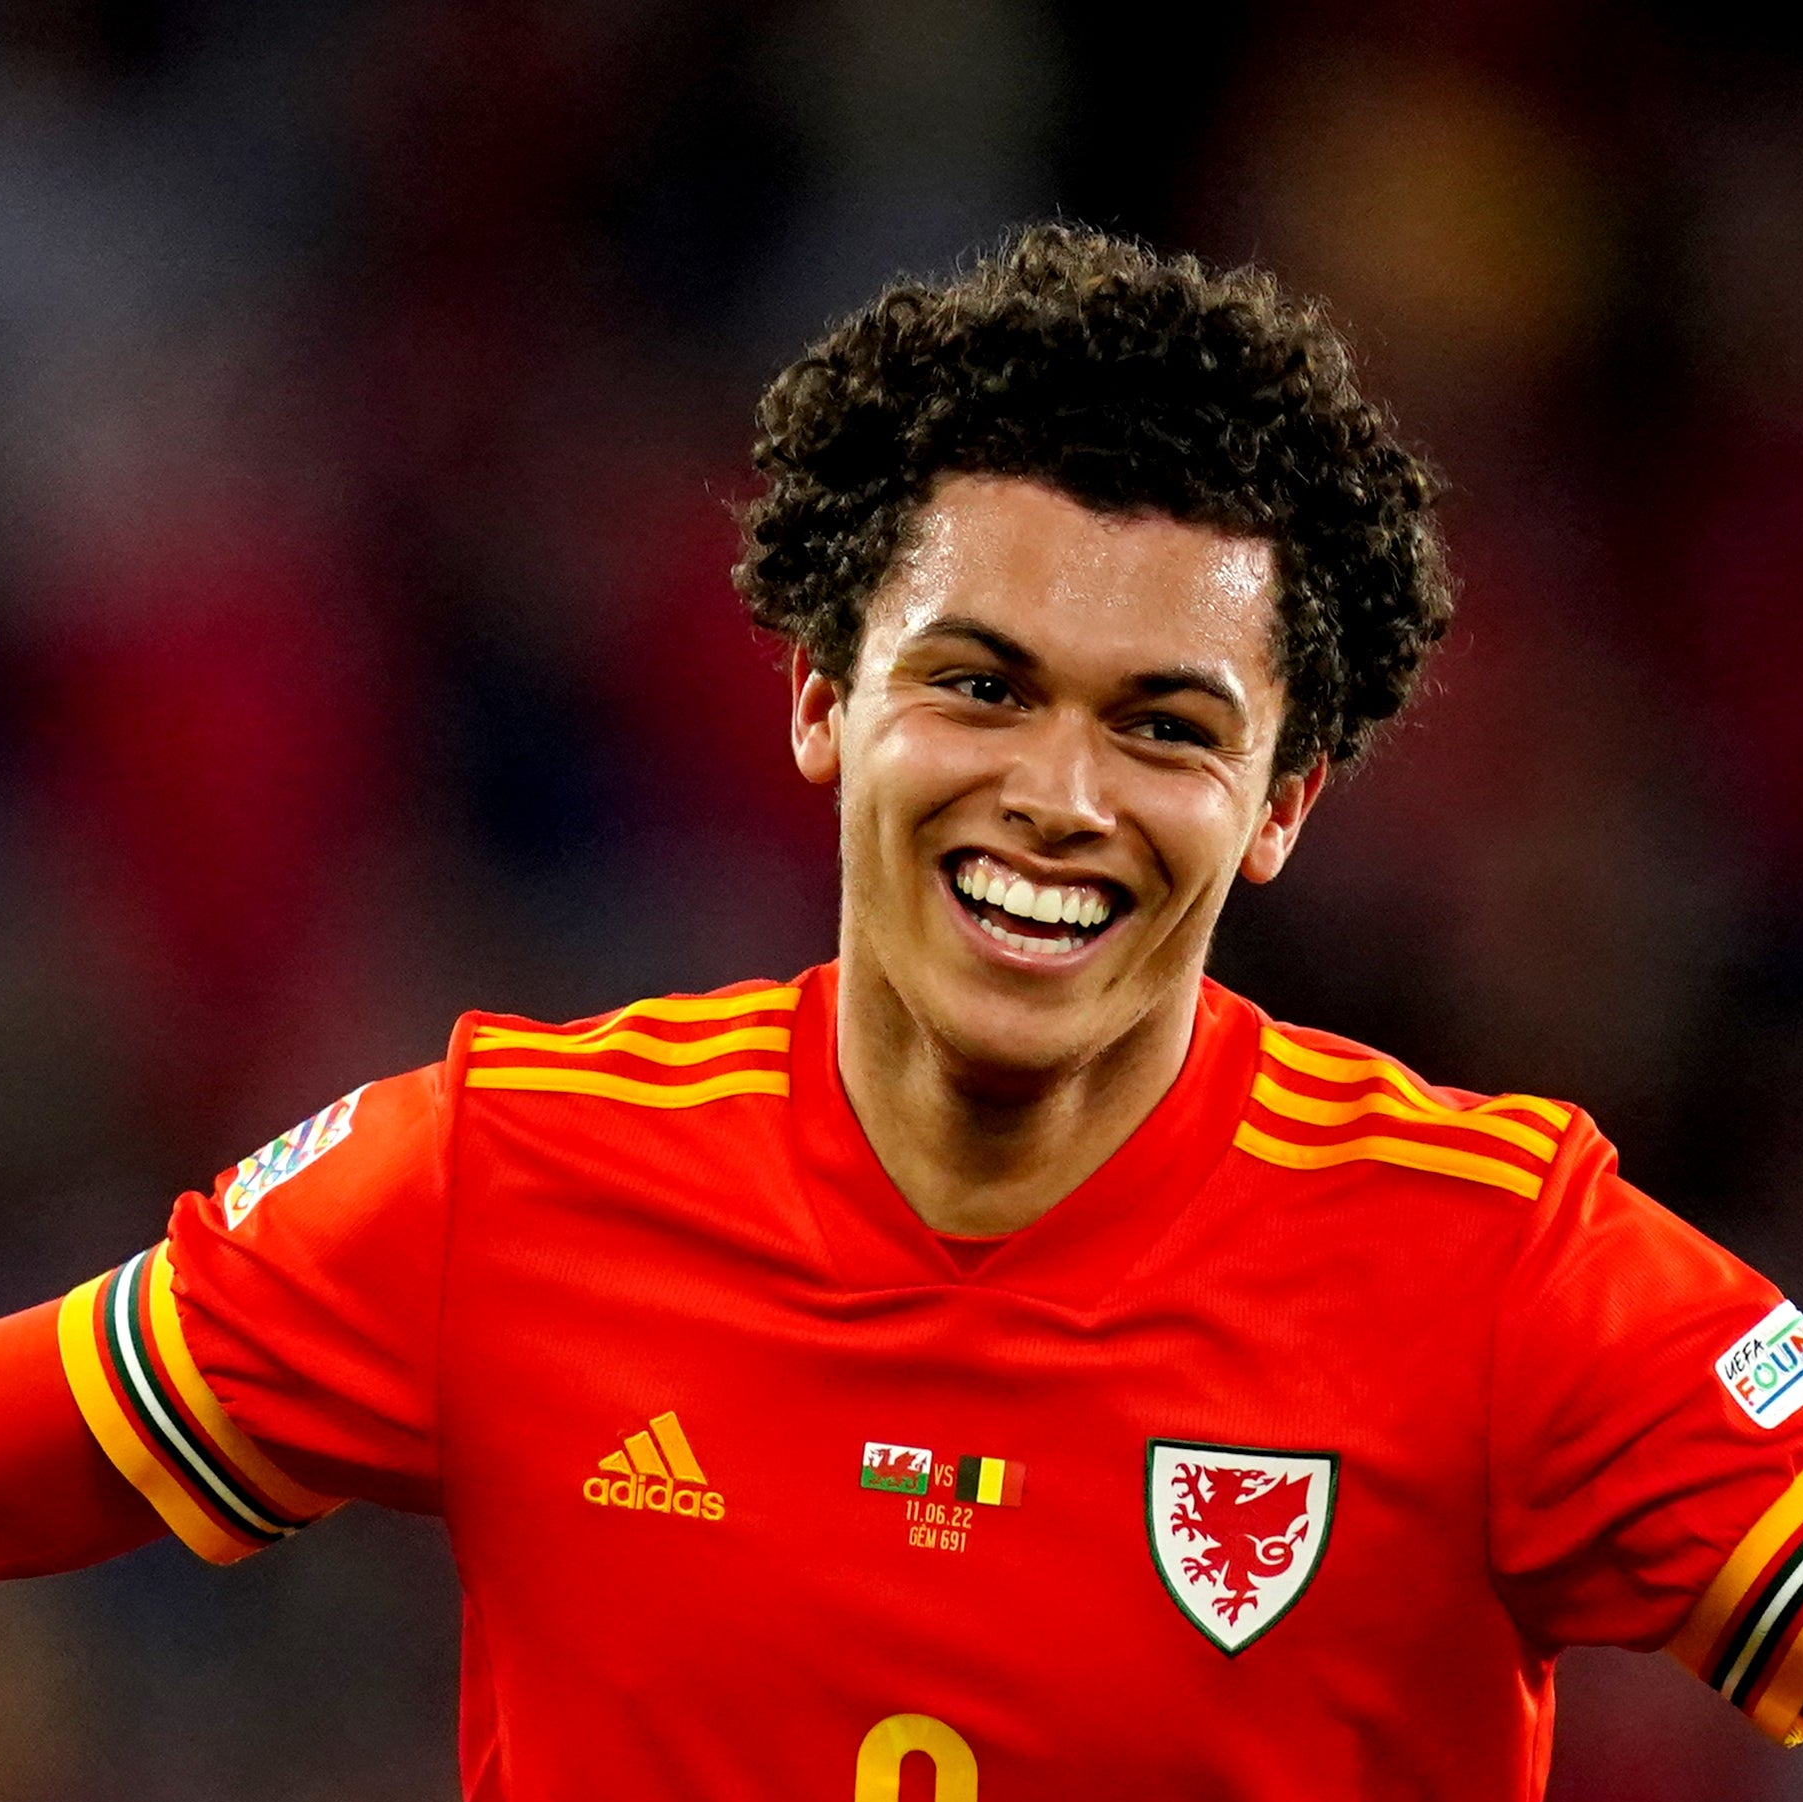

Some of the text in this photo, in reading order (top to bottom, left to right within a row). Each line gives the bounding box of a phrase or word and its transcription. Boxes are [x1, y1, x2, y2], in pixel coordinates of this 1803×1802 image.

[1724, 1338, 1764, 1381] UEFA
[934, 1463, 955, 1487] VS
[583, 1474, 725, 1521] adidas
[906, 1500, 973, 1529] 11.06.22
[909, 1523, 967, 1553] GÊM 691
